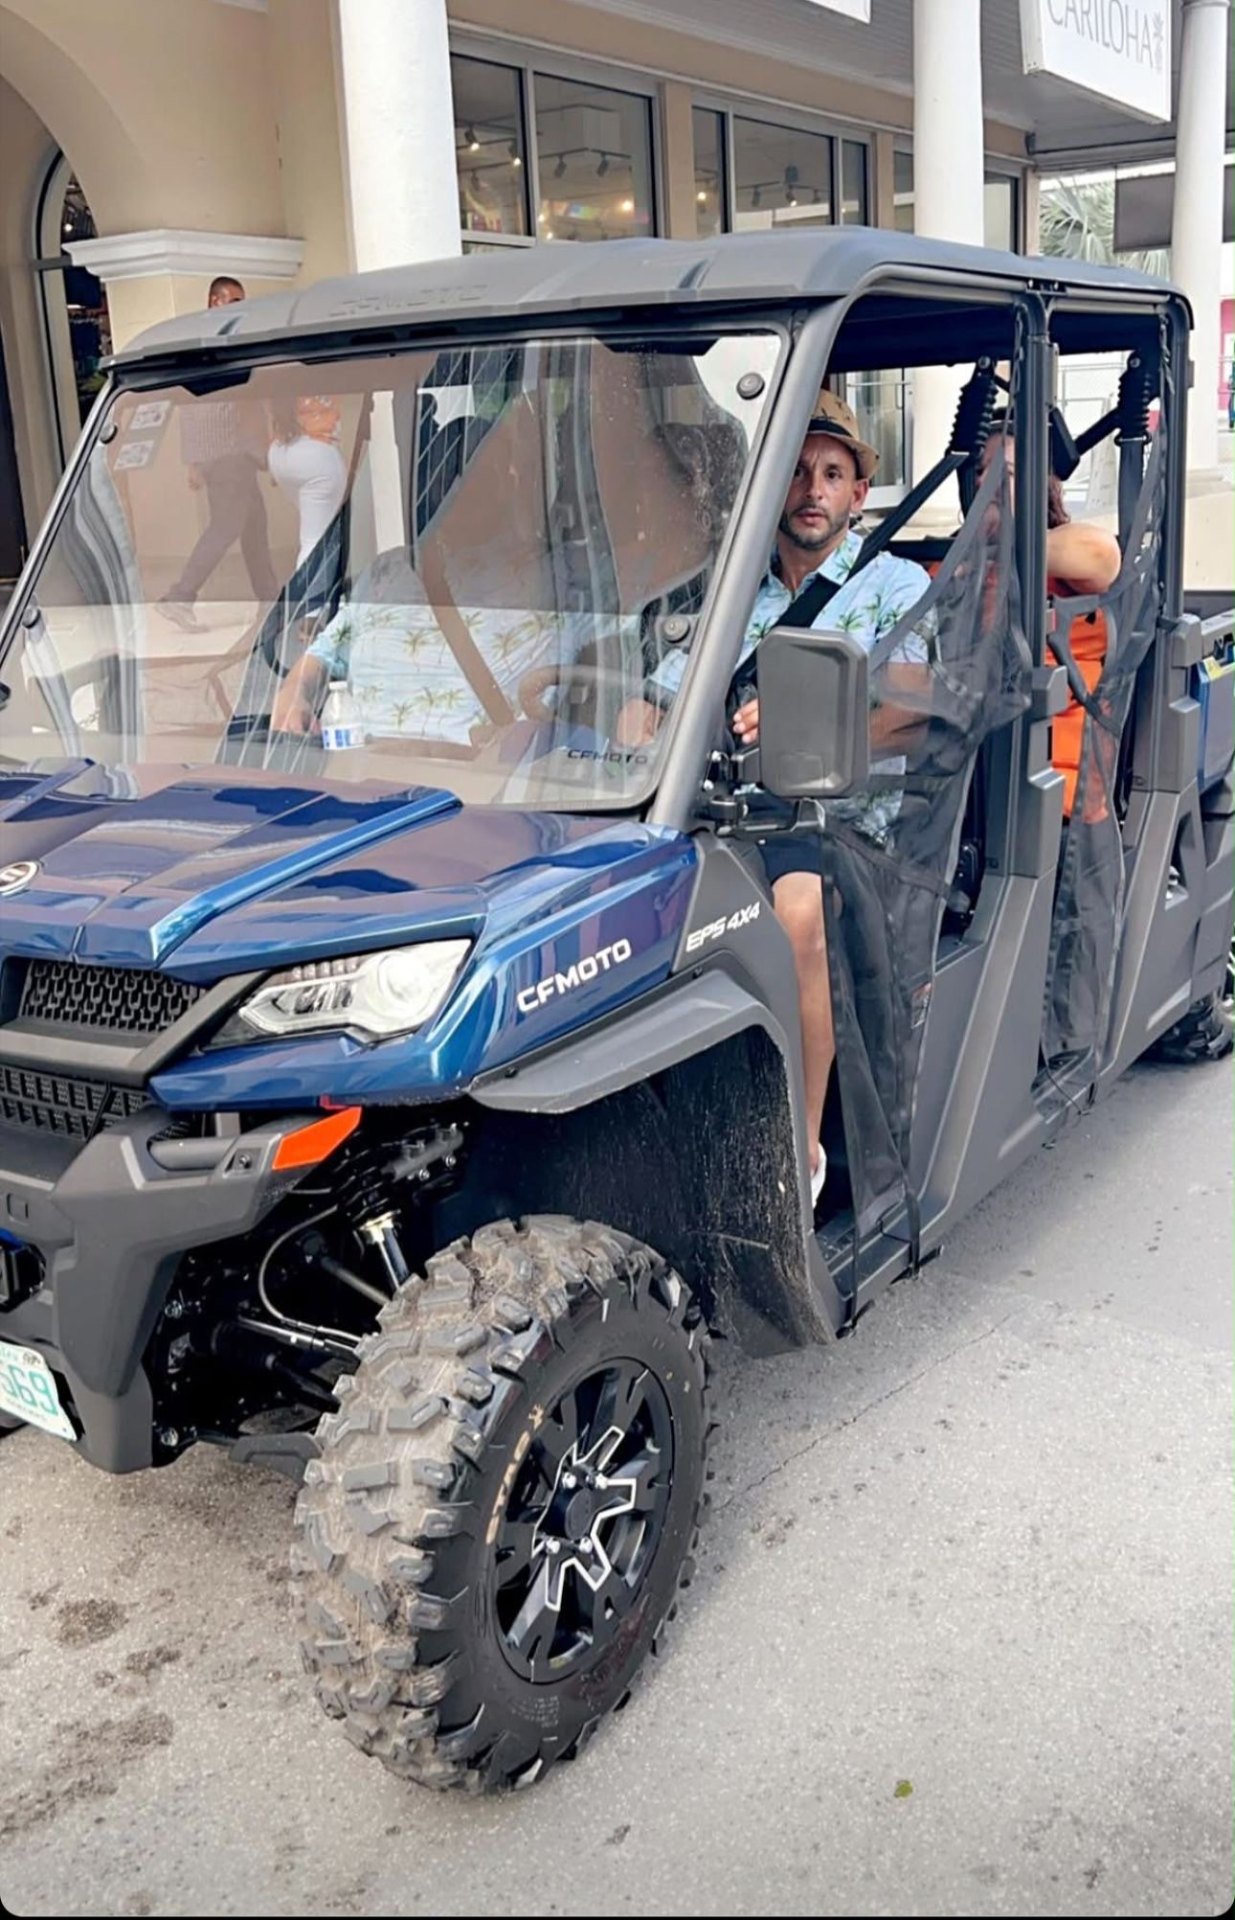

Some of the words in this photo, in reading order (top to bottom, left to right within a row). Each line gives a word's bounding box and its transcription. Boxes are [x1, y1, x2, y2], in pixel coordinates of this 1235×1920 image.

[567, 749, 648, 764] CFMOTO
[686, 916, 727, 952] EPS
[517, 938, 632, 1013] CFMOTO
